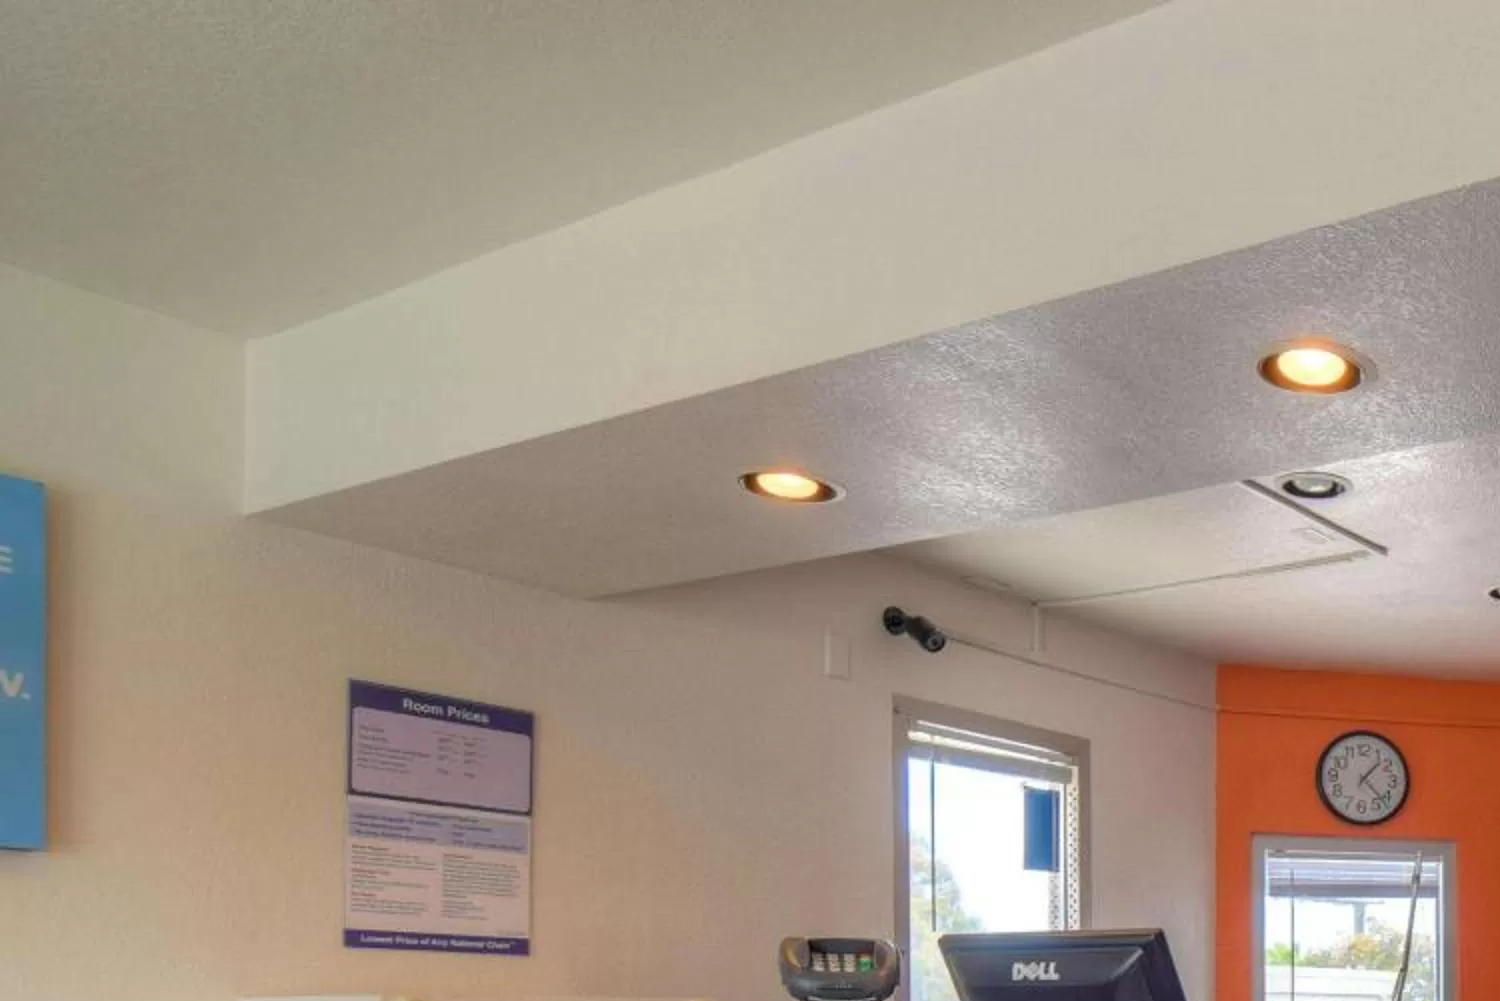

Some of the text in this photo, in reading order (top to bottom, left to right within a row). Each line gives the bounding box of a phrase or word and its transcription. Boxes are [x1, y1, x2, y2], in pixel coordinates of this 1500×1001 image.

[403, 697, 490, 724] Room Prices
[1387, 774, 1397, 789] 3
[1343, 795, 1355, 811] 7
[1356, 799, 1367, 814] 6
[1011, 961, 1061, 981] DELL
